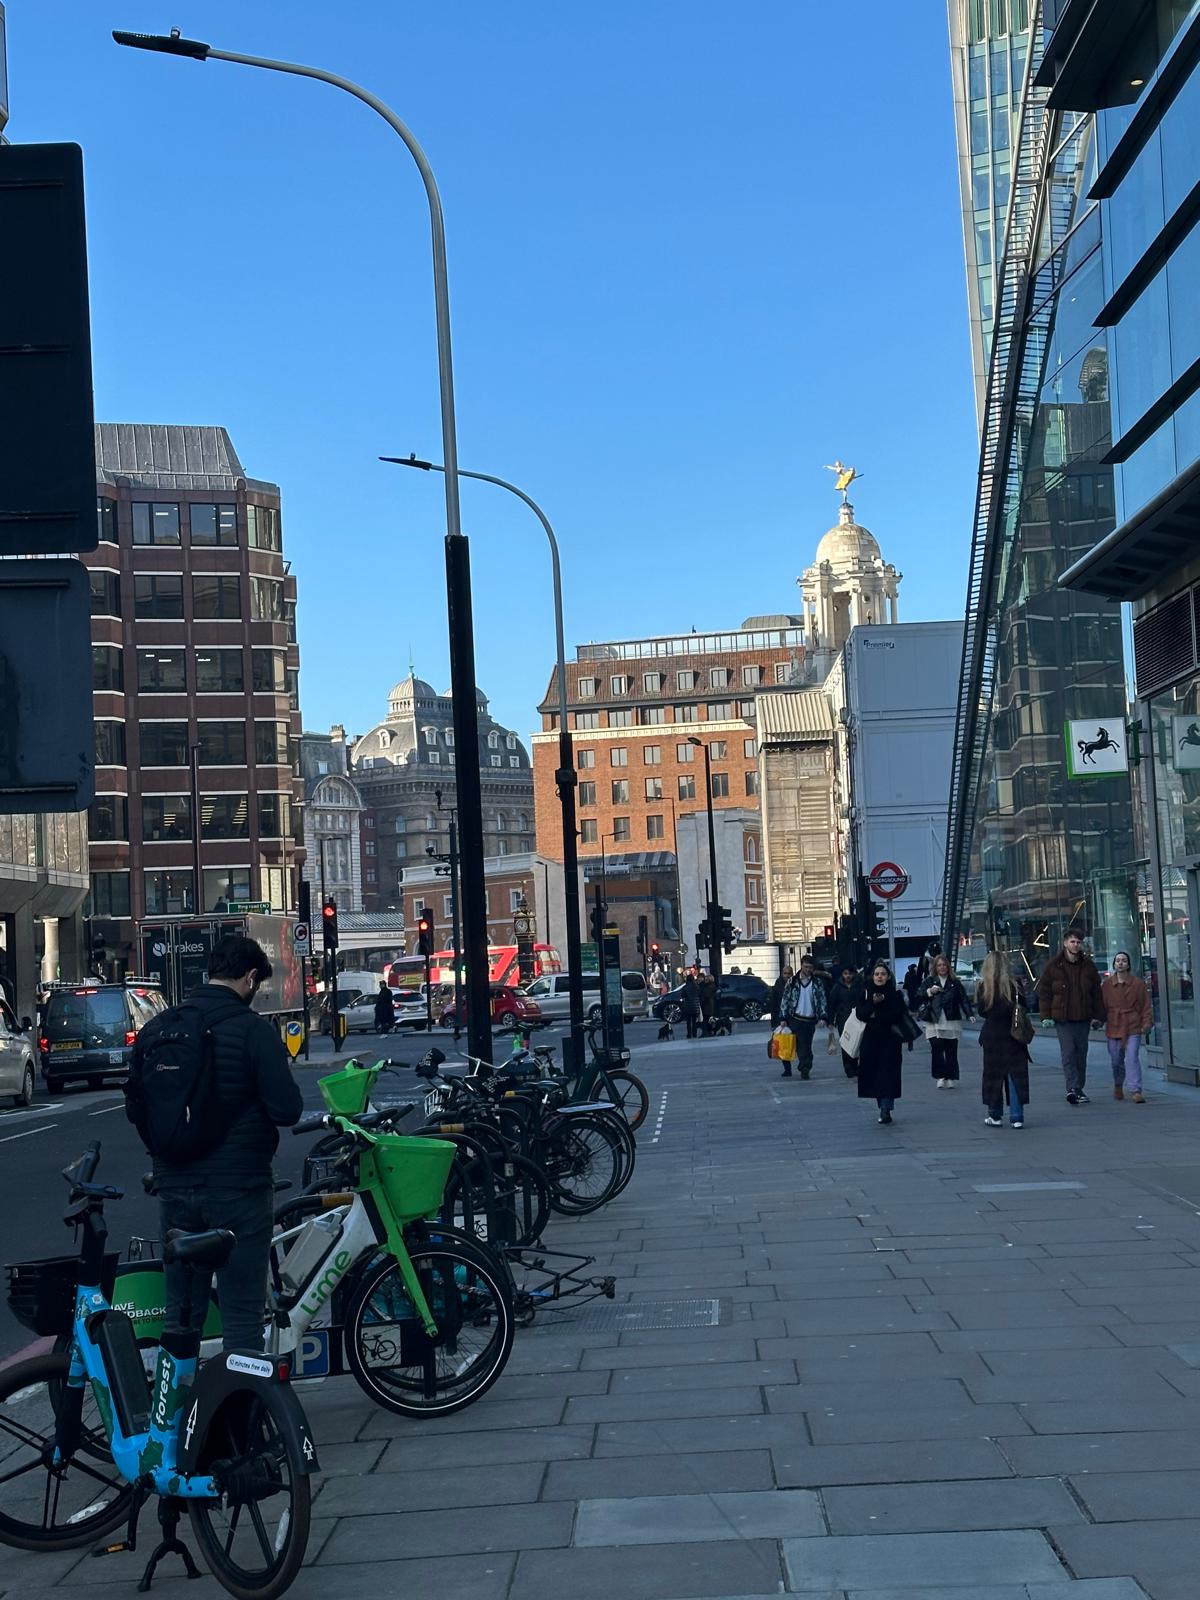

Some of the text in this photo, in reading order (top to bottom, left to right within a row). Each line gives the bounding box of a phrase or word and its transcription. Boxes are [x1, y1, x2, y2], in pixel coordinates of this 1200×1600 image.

[167, 941, 204, 953] brakes
[300, 1250, 352, 1316] Lime
[124, 1307, 167, 1319] DBACK
[235, 1360, 250, 1369] minutes
[251, 1362, 260, 1371] free
[260, 1365, 270, 1374] daily
[295, 1335, 322, 1374] P
[156, 1358, 171, 1425] forest
